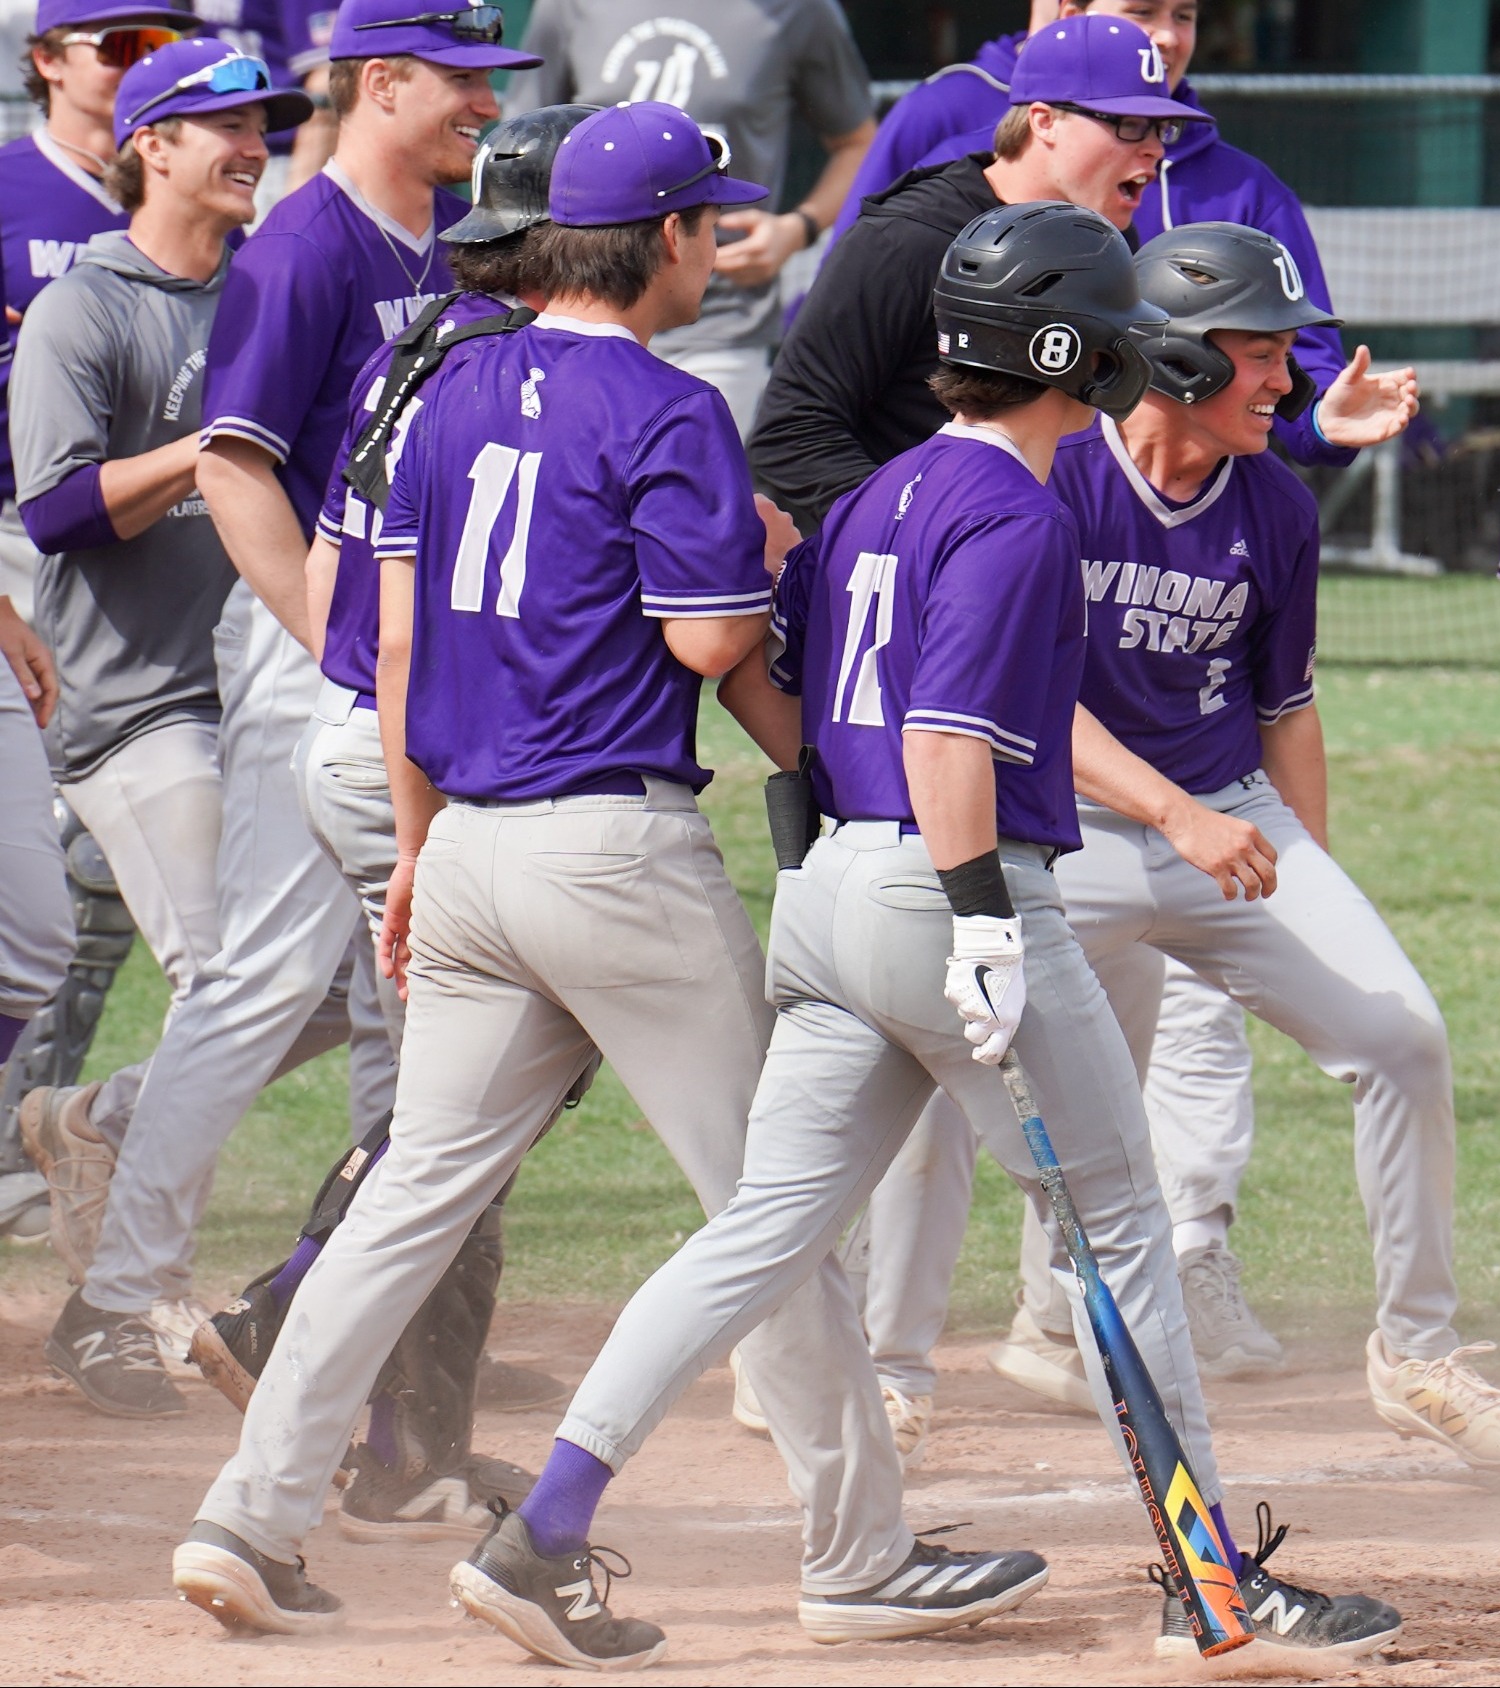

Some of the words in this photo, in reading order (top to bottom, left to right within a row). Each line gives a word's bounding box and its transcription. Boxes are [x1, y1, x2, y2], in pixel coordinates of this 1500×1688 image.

[1039, 330, 1072, 369] 8
[163, 365, 194, 421] KEEPING
[451, 441, 544, 619] 11
[1080, 559, 1249, 620] WINONA
[832, 552, 899, 726] 12
[1118, 608, 1240, 654] STATE
[1199, 657, 1232, 716] 2
